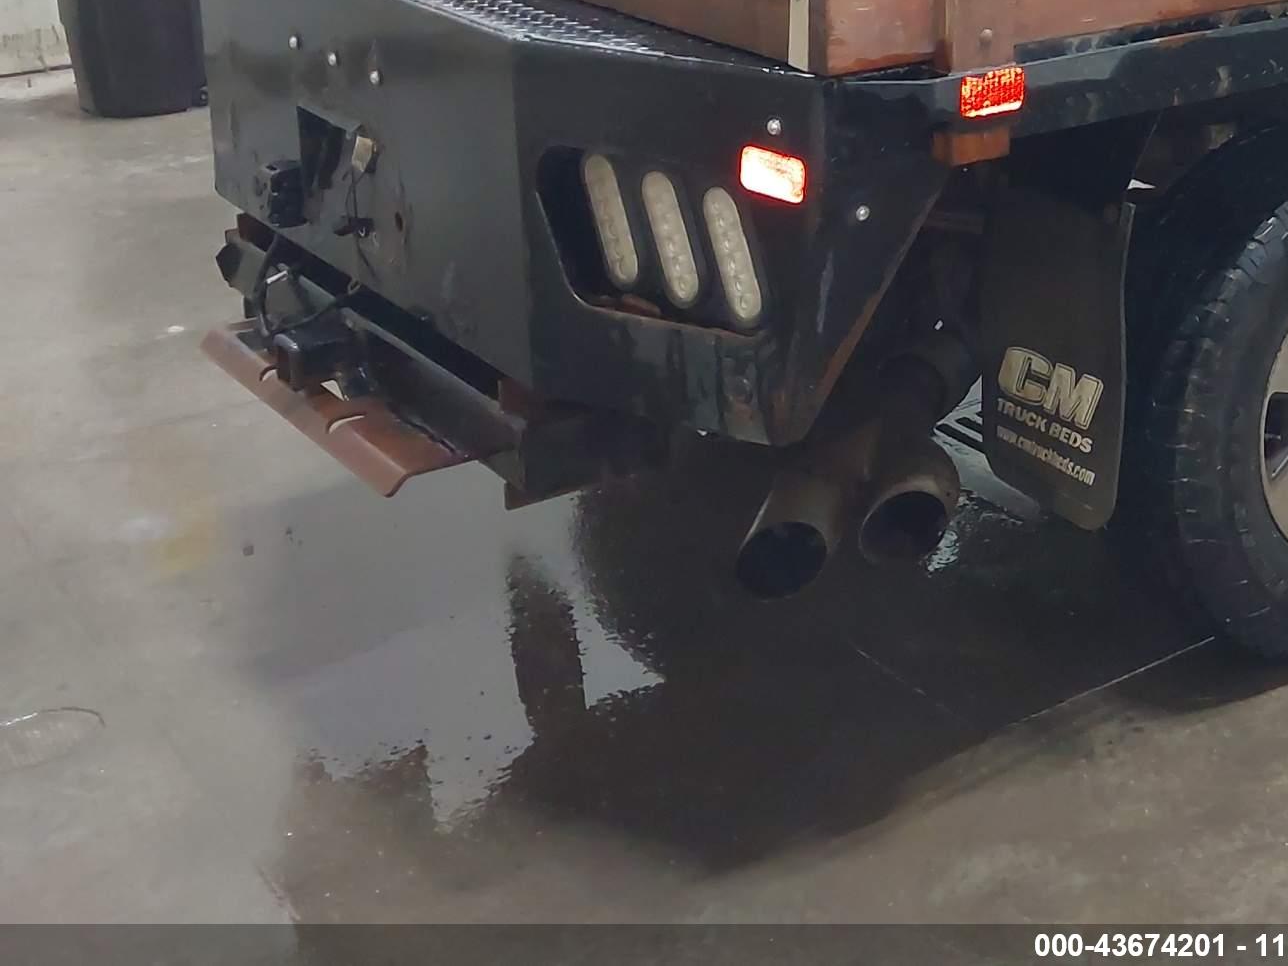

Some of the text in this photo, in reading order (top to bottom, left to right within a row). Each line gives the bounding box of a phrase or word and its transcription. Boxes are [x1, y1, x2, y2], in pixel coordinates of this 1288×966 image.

[997, 346, 1104, 431] CM
[997, 397, 1094, 454] TRUCK BEDS
